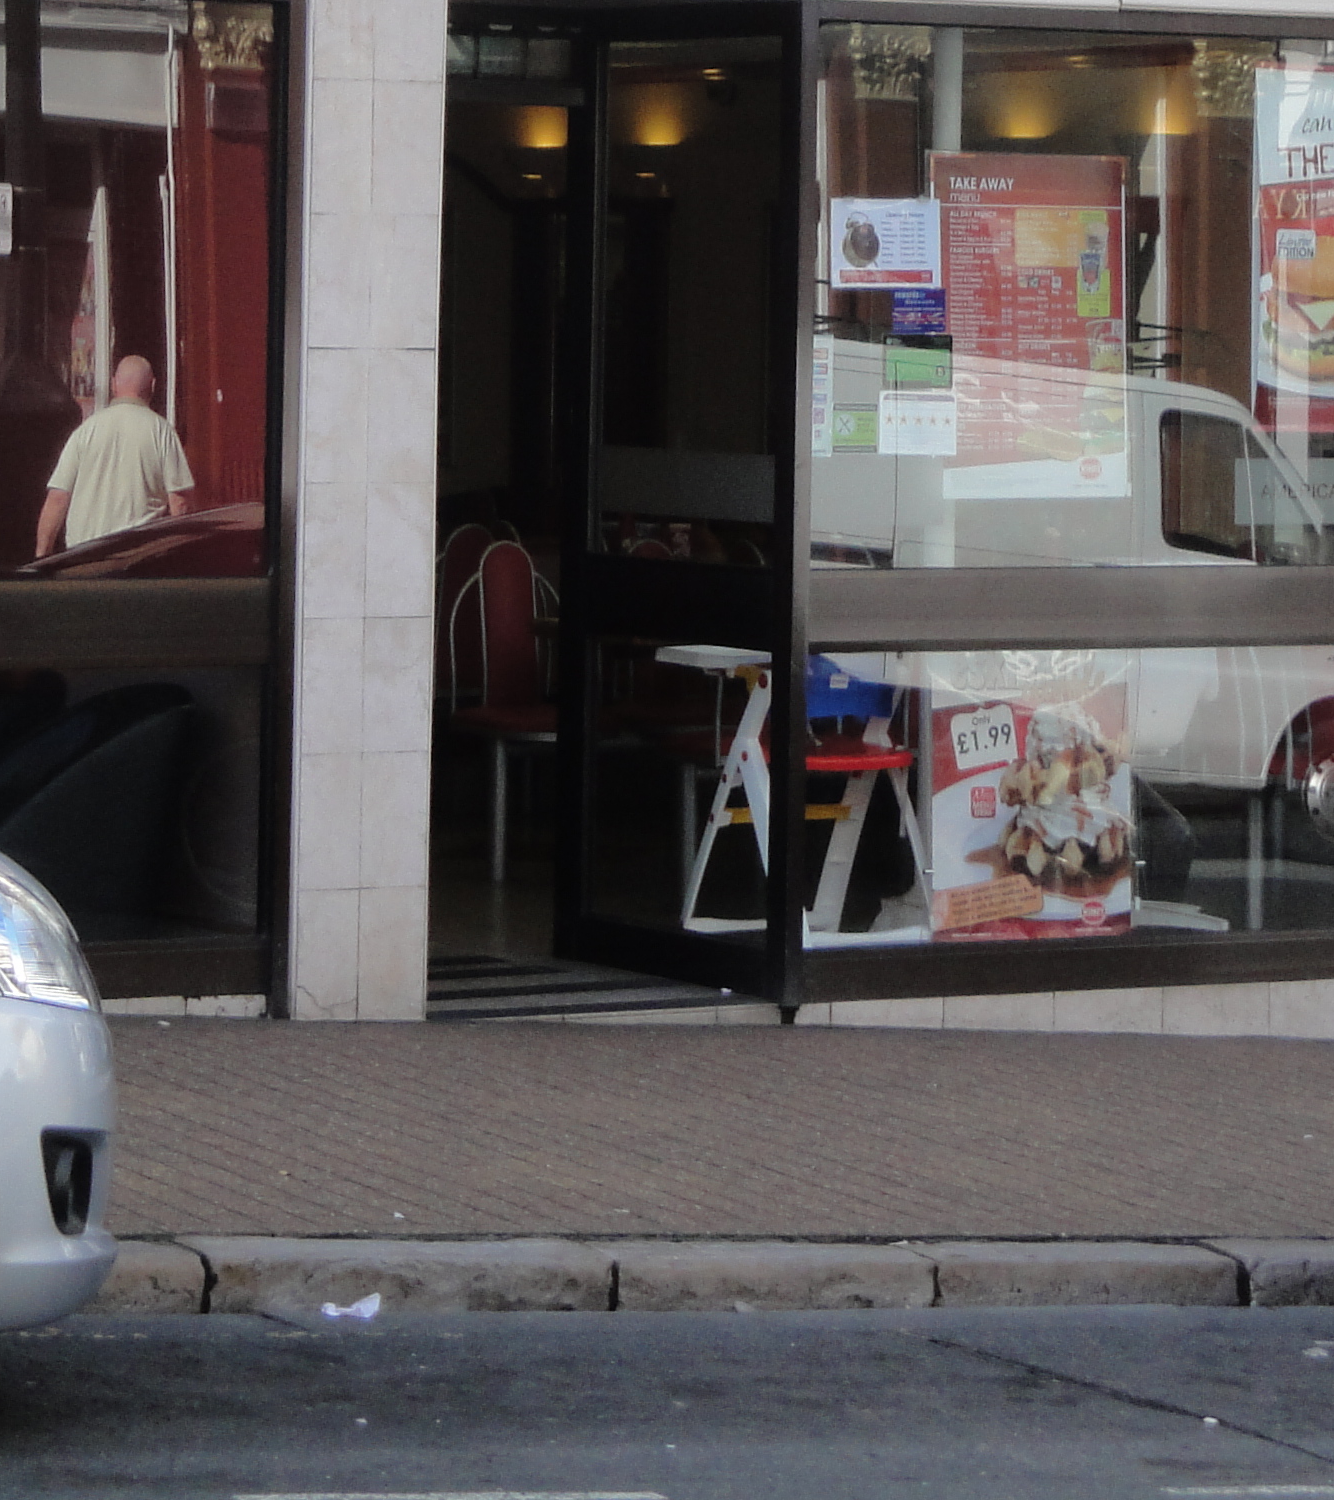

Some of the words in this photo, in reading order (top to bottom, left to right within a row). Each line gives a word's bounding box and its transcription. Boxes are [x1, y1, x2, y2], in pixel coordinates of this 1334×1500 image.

[1301, 118, 1332, 134] can
[949, 176, 977, 190] TAKE
[979, 177, 1015, 191] AWAY
[949, 192, 981, 203] menu
[971, 714, 992, 727] Only
[956, 723, 1012, 755] £1.99
